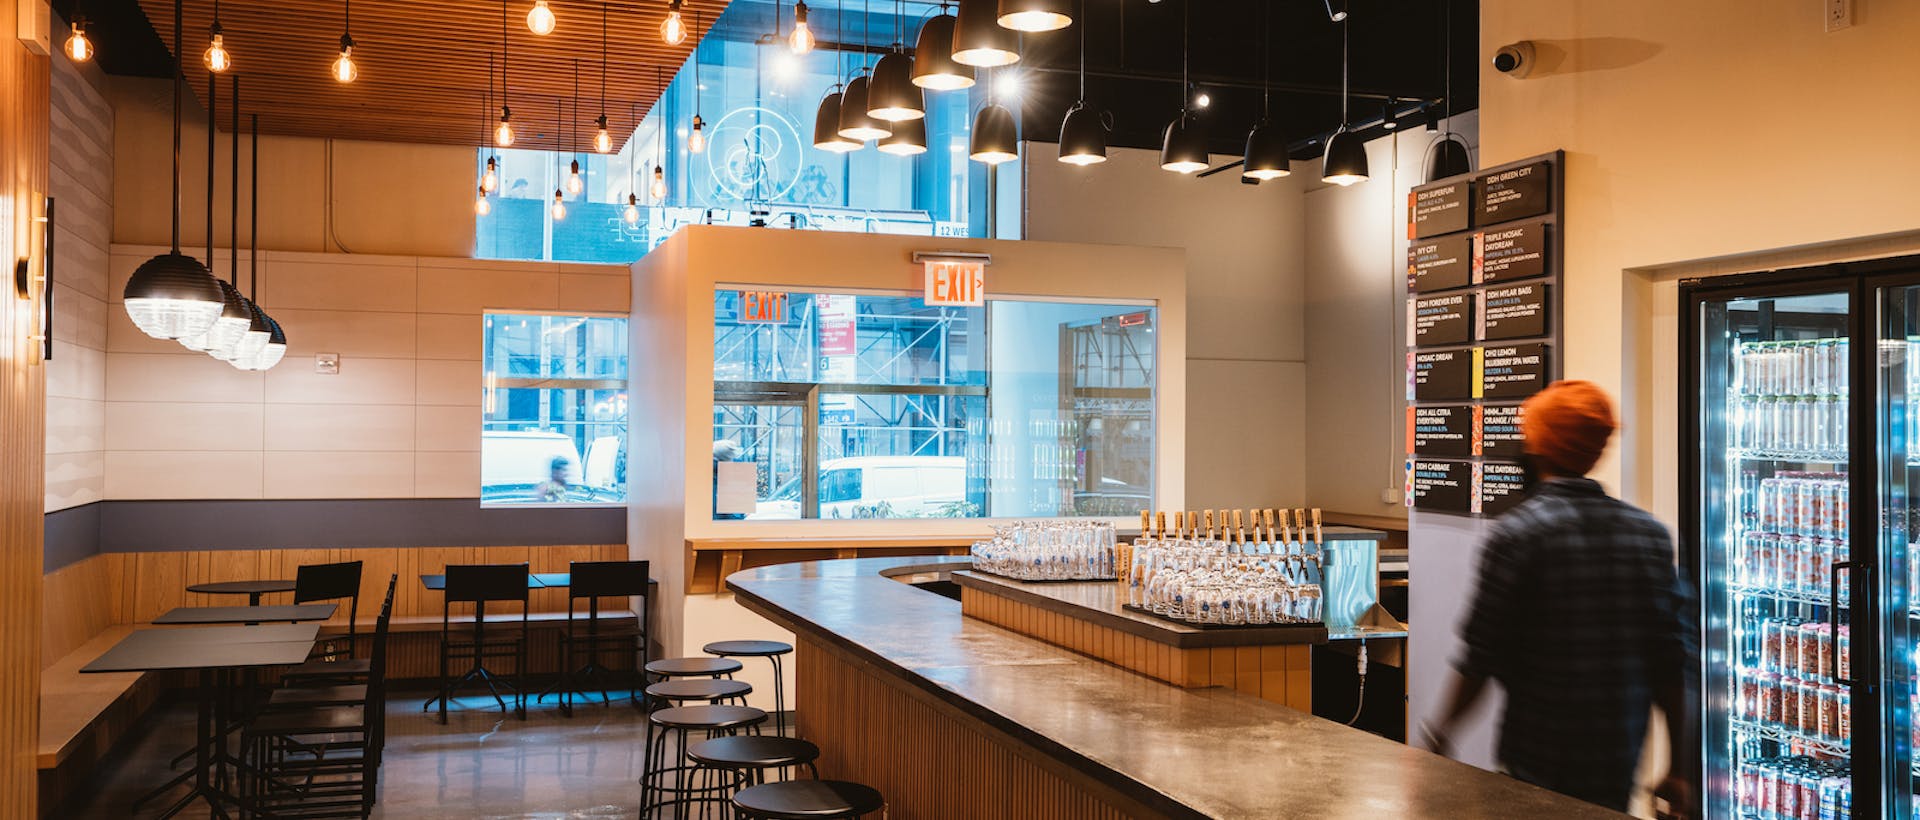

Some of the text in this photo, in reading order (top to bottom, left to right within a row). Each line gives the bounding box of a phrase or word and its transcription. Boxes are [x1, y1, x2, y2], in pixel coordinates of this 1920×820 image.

[1487, 167, 1533, 184] DDH GREEN CITY
[1418, 193, 1428, 201] DDH
[941, 226, 950, 236] 12
[1485, 228, 1524, 242] TRIPLE MOSAIC
[1426, 245, 1437, 254] CITY
[1485, 240, 1514, 252] DAYDREAM
[933, 263, 978, 302] EXIT
[1487, 286, 1532, 299] DDH MYLAR BAGS
[745, 291, 784, 320] EXIT
[1417, 295, 1463, 308] DDH FOREVER EVER
[1497, 347, 1516, 357] LEMON
[1417, 353, 1453, 362] MOSAIC DREAM
[1485, 355, 1540, 367] BLUEBERRY SPA WATER
[1417, 408, 1452, 416] DDH ALL CITRA
[1417, 416, 1446, 425] EVERYTHING
[1484, 416, 1507, 425] ORANGE
[1416, 462, 1450, 471] DDH CABBAGE
[1484, 465, 1494, 473] THE
